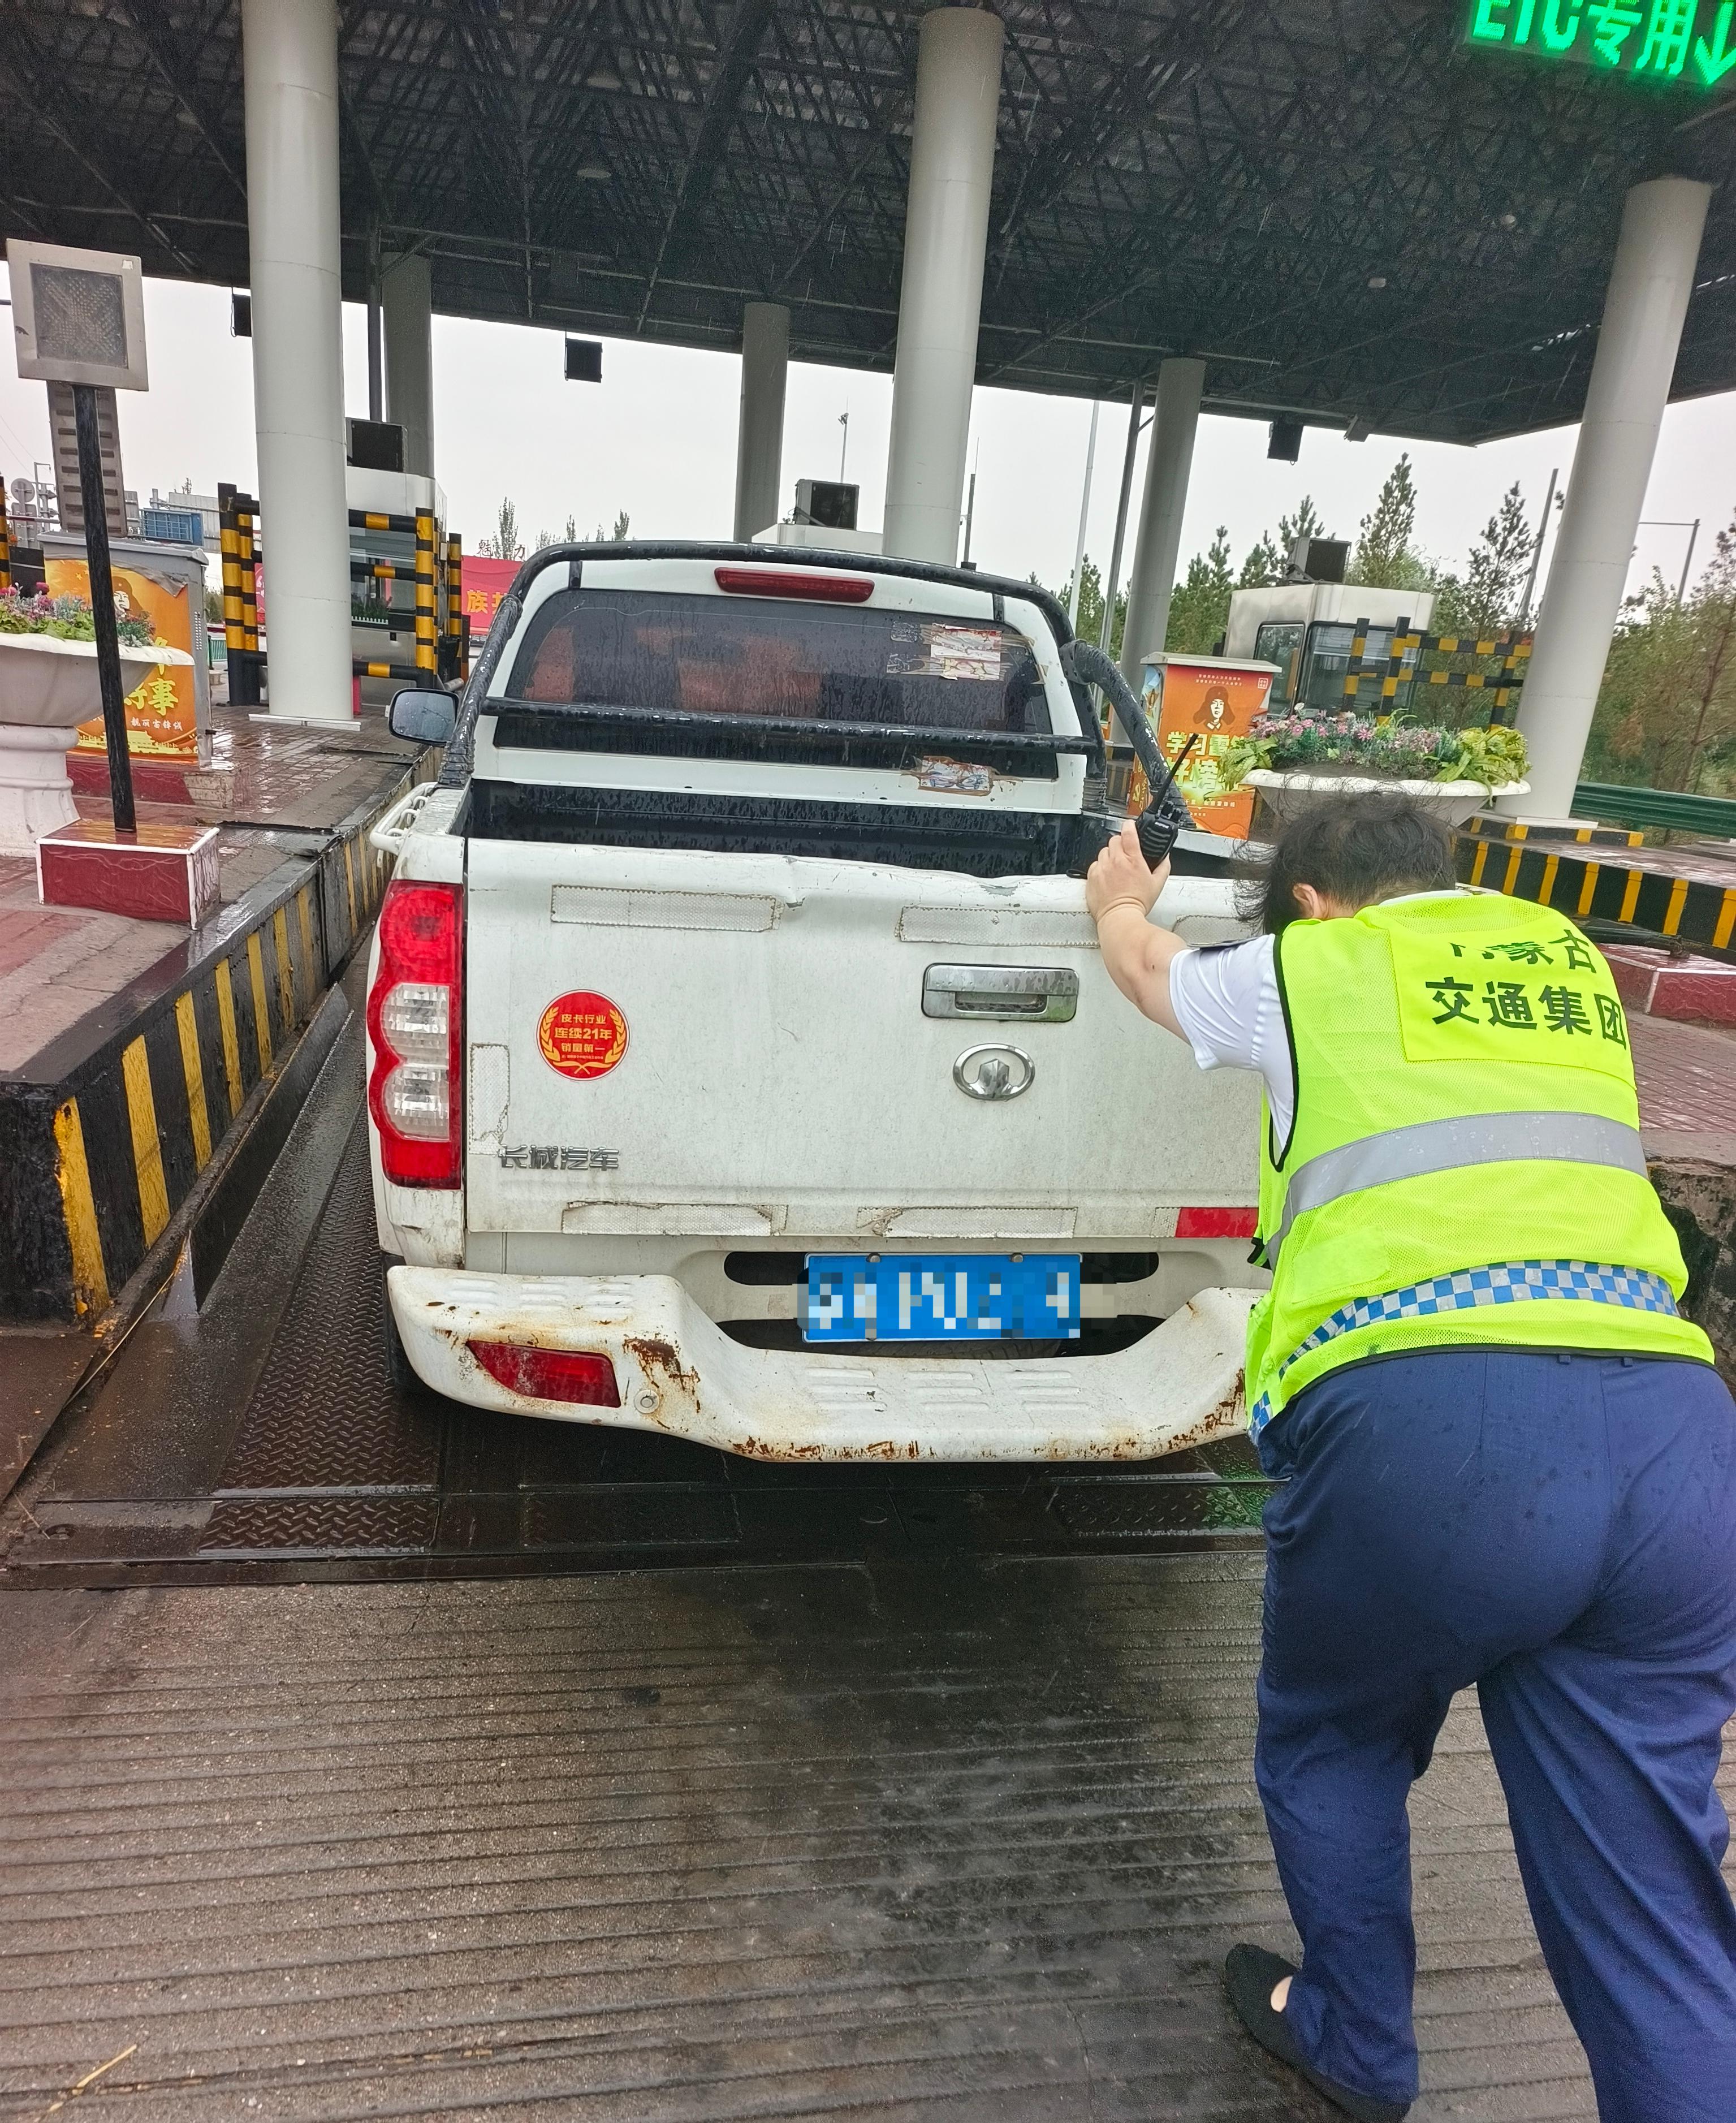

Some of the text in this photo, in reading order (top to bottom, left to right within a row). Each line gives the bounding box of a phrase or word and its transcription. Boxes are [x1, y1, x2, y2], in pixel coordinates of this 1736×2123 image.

[1167, 757, 1235, 791] 好榜
[1449, 929, 1597, 974] 蒙古
[561, 1013, 606, 1025] 皮卡行业
[1425, 976, 1627, 1051] 交通集团
[554, 1026, 612, 1040] 连续21年
[561, 1042, 606, 1053] 销量第一
[498, 1144, 619, 1171] 长城汽车
